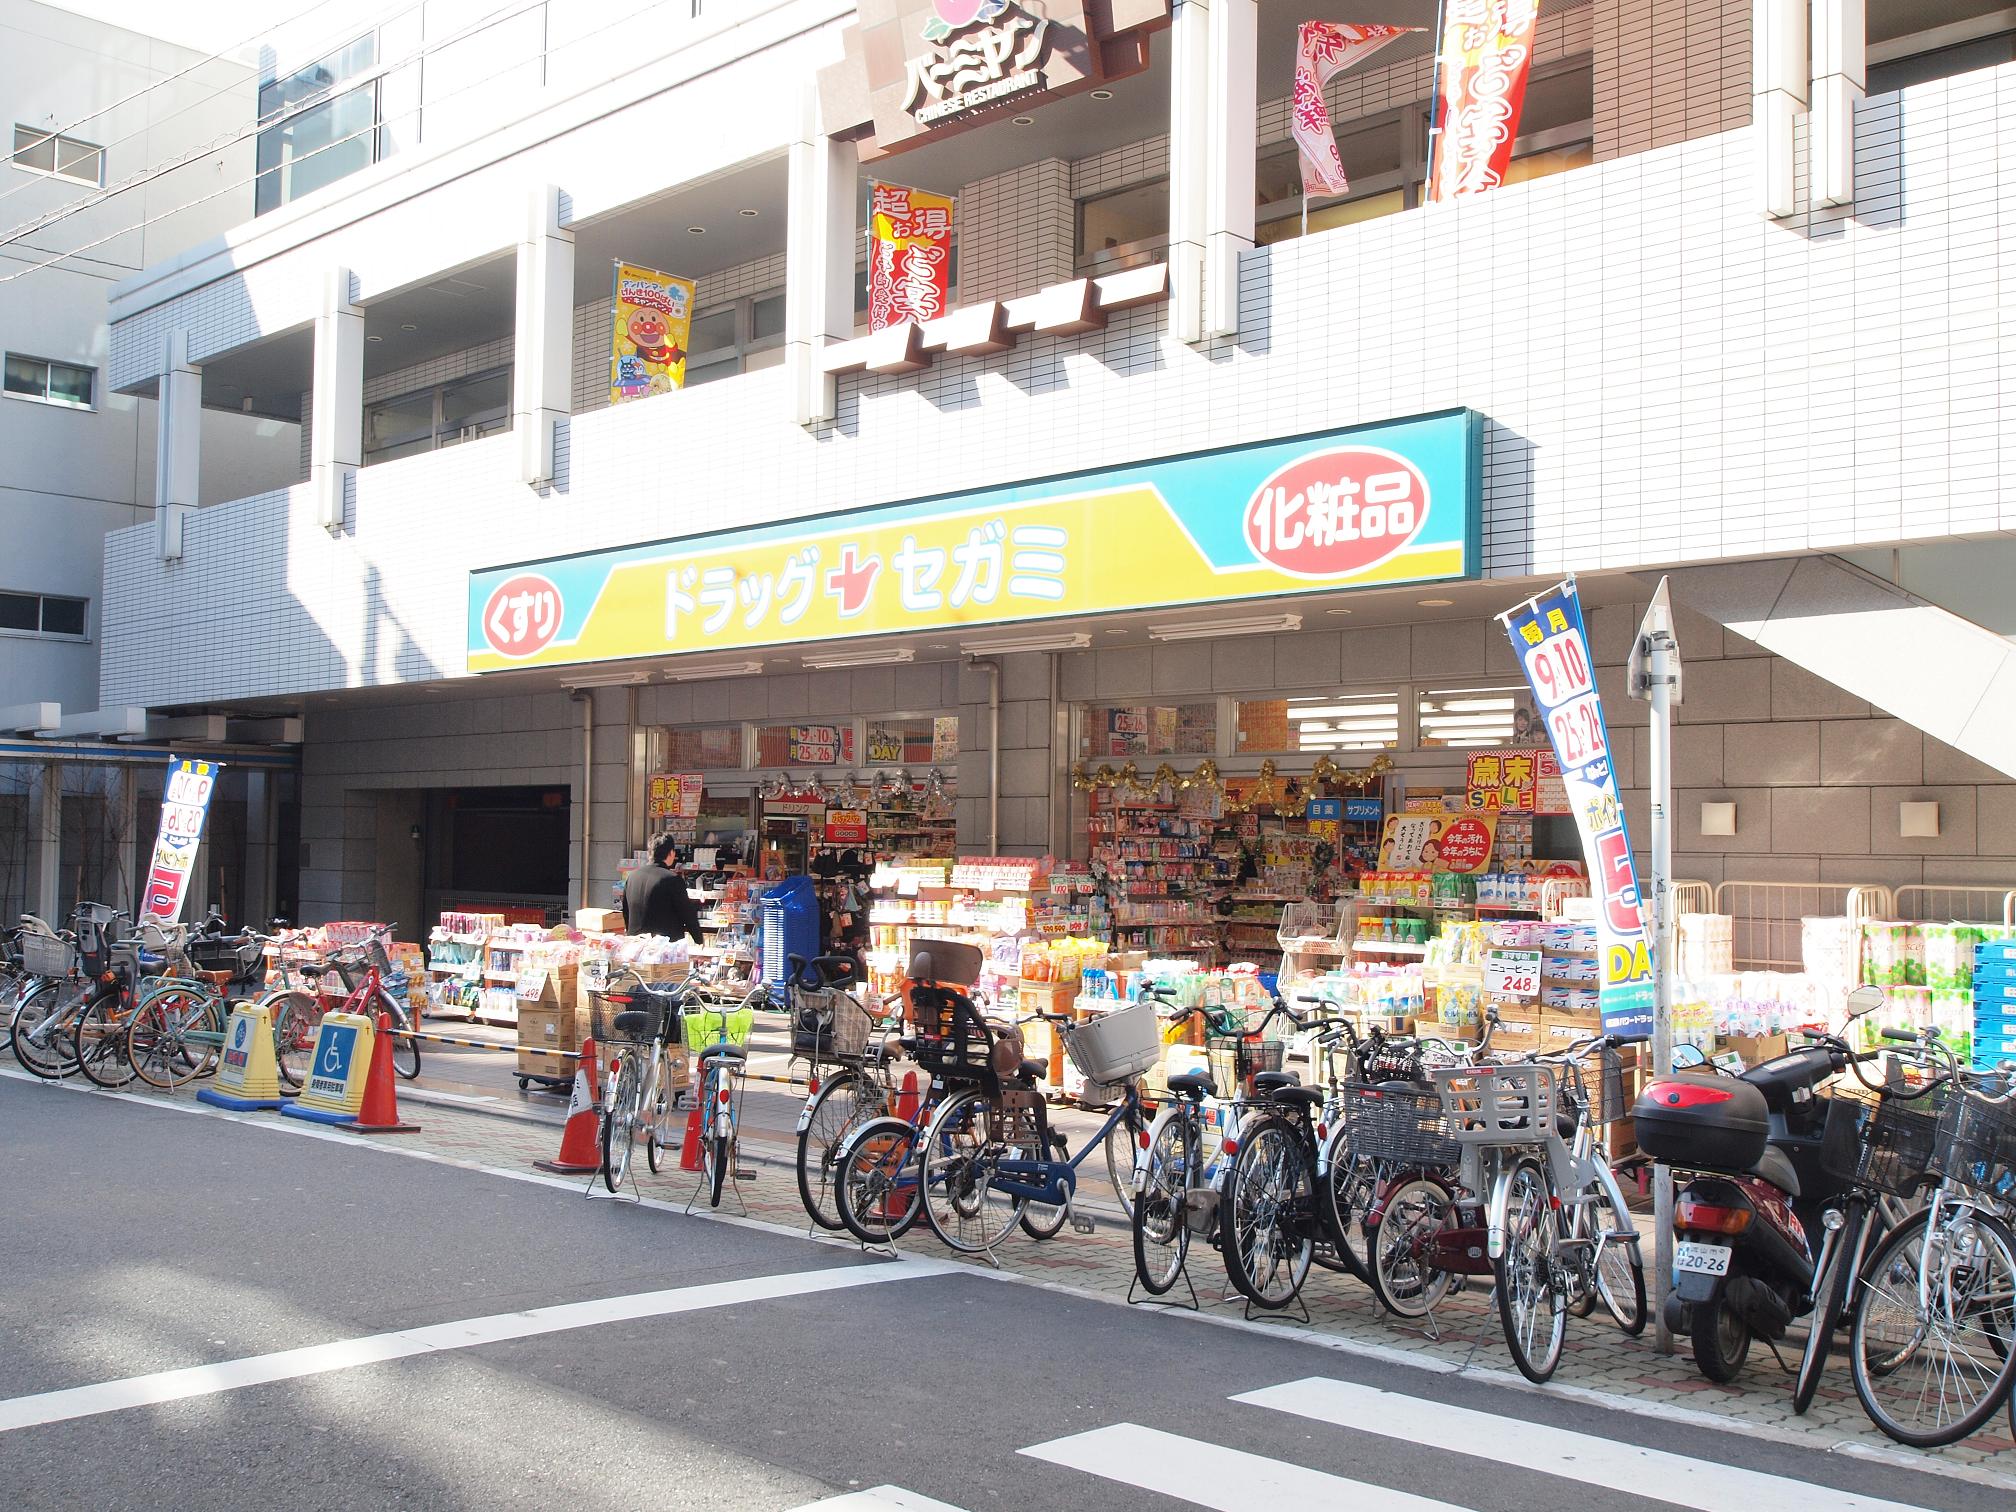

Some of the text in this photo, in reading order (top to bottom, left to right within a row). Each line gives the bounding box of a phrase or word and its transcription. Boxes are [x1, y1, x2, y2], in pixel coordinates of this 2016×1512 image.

[901, 17, 1048, 111] バーミヤン
[915, 68, 1038, 124] CHINESE RESTAURANT
[873, 188, 952, 239] 超お得
[622, 281, 665, 293] アンパンマン
[1253, 471, 1415, 554] 化粧品
[665, 519, 1067, 640] ドラッグ セガミ
[490, 591, 555, 644] くすり
[1519, 608, 1568, 645] 毎月
[1472, 755, 1534, 787] 歳末
[652, 777, 680, 799] 歳末
[1471, 786, 1533, 808] SALE
[652, 800, 680, 815] SALE
[783, 804, 809, 813] ドリンク
[1312, 805, 1334, 815] 目薬
[1347, 805, 1381, 816] サプリメント
[1309, 820, 1337, 834] 歳末
[1460, 823, 1475, 831] 花王
[1503, 976, 1532, 991] 248
[1685, 1256, 1725, 1271] 20-26
